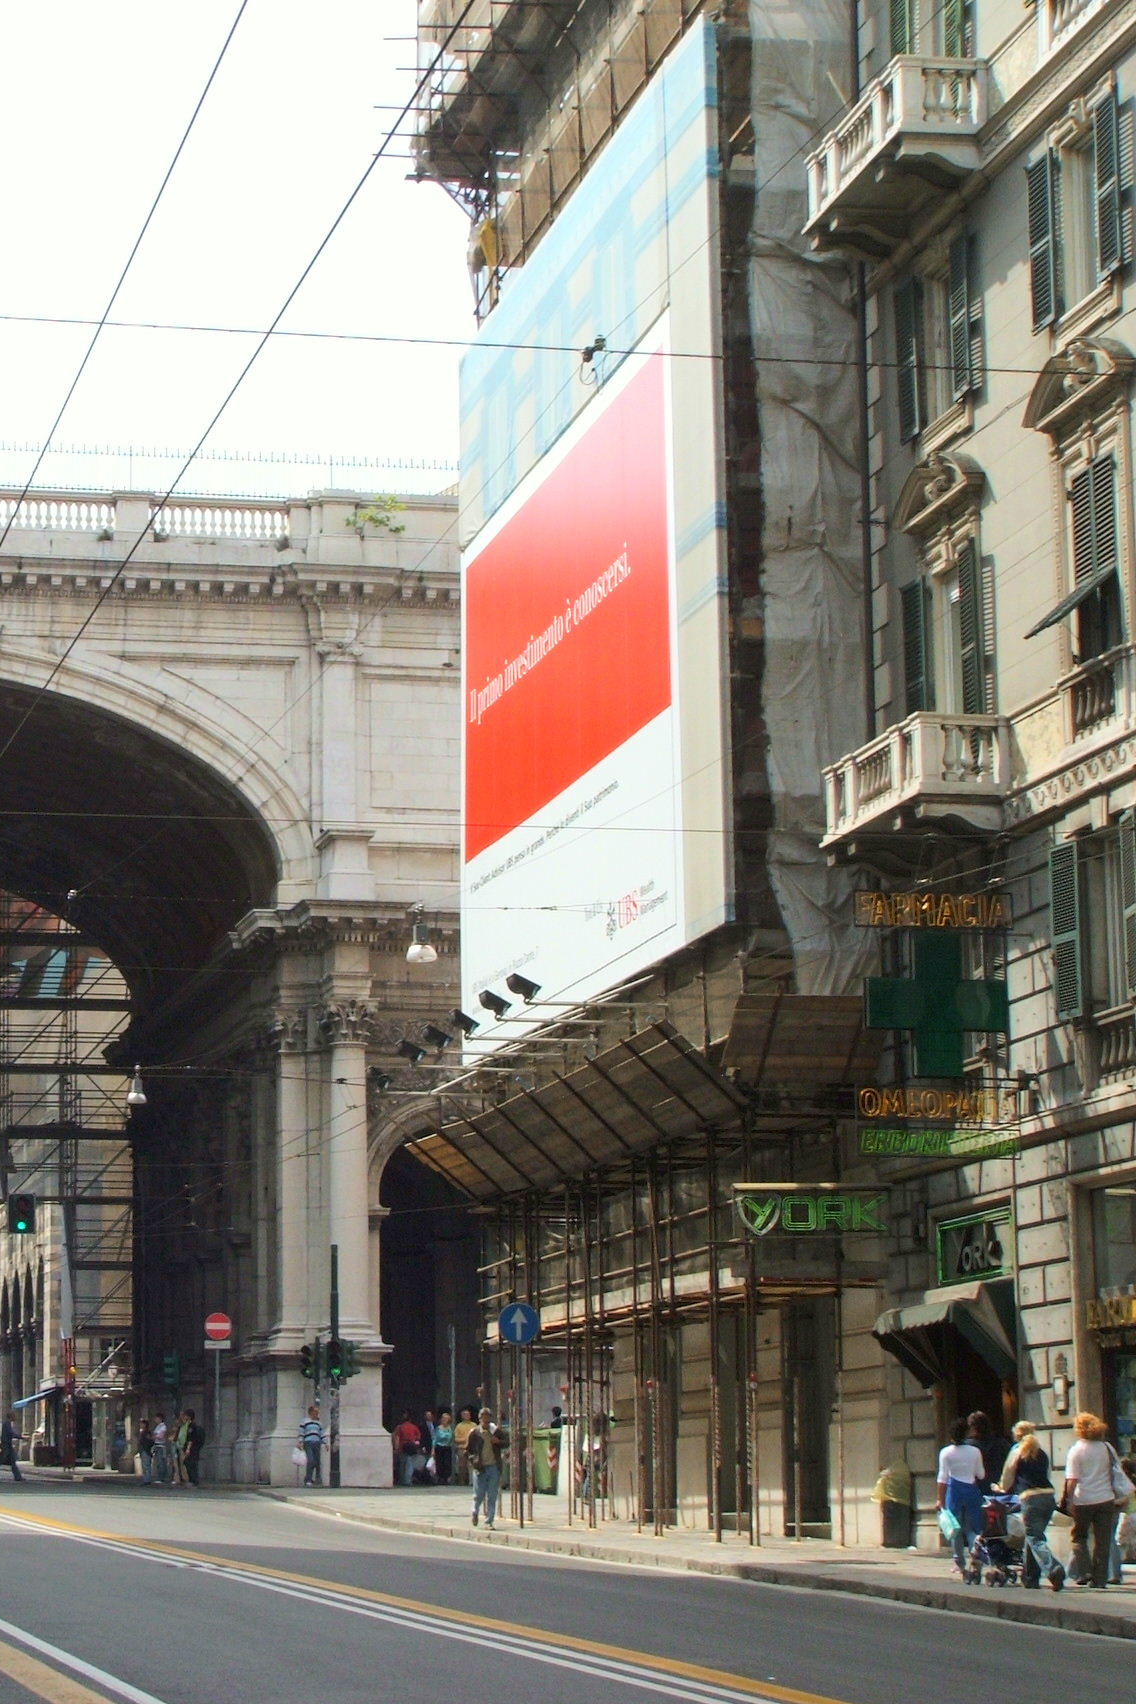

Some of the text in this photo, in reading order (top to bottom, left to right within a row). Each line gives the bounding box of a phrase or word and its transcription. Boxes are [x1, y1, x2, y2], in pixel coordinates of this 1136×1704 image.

[470, 541, 631, 725] Il primo investimento è conoscersi.
[618, 889, 638, 929] UBS
[856, 892, 1012, 927] FARMACIA
[740, 1193, 890, 1234] YORK
